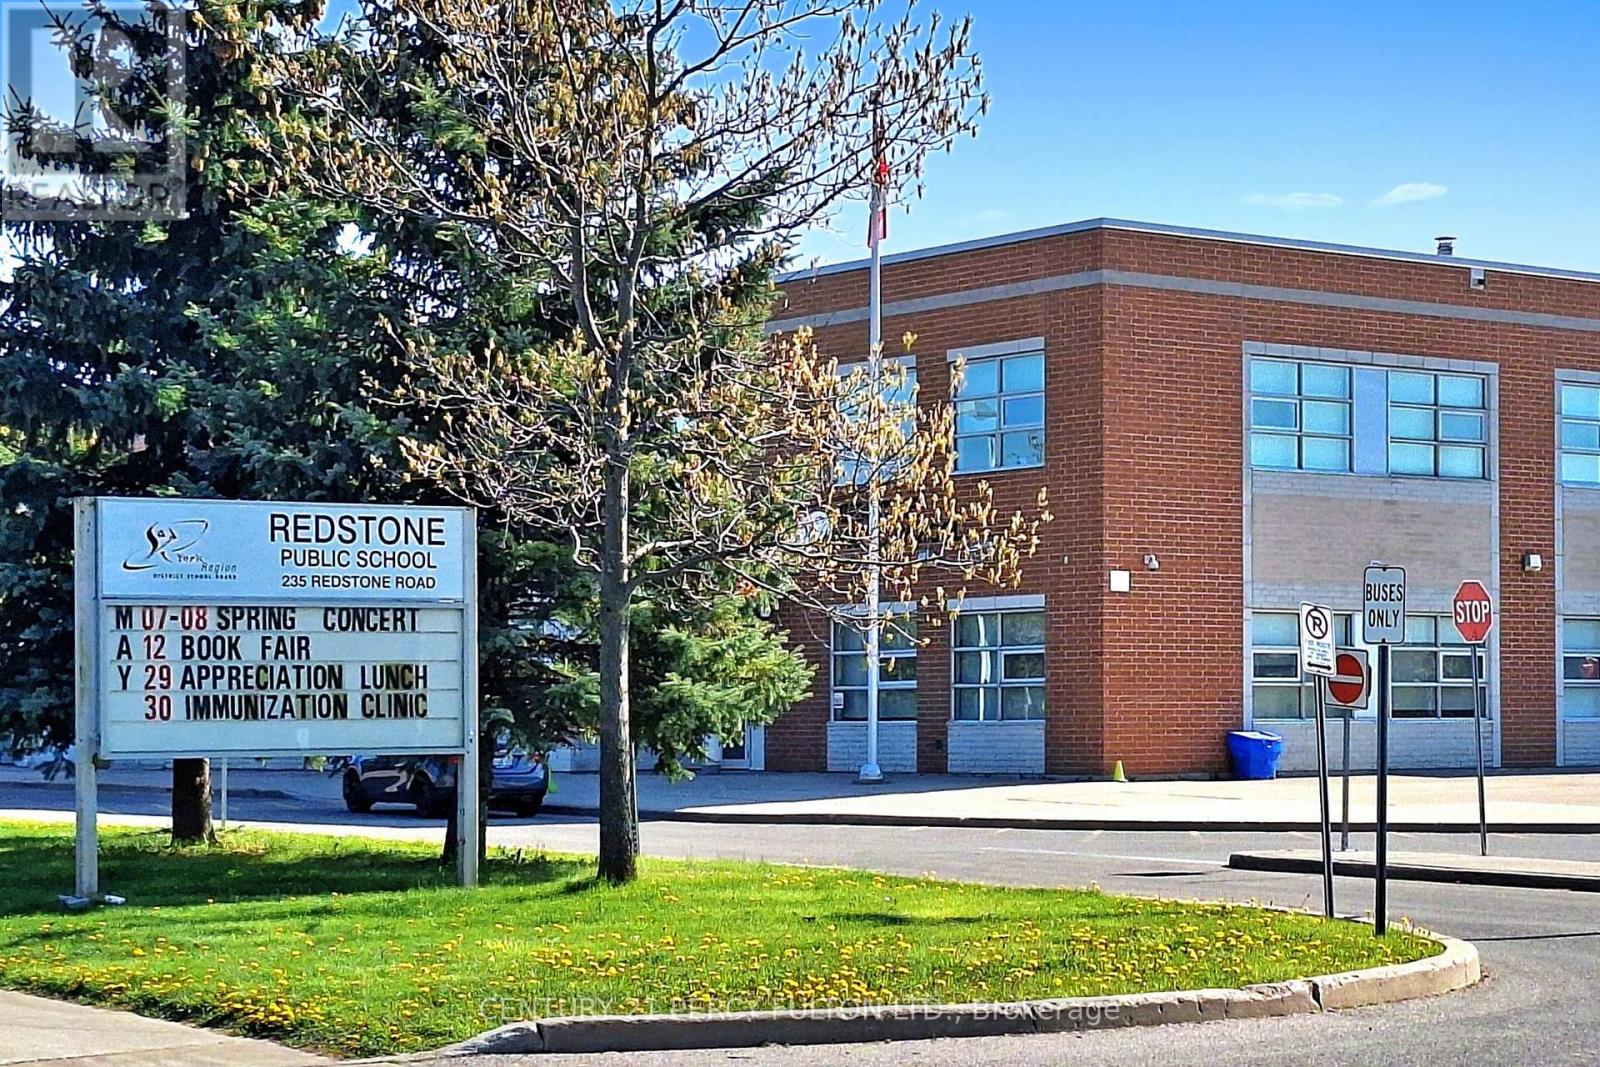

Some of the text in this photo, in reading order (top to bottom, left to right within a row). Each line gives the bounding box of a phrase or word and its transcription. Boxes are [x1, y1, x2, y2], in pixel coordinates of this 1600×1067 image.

[270, 513, 446, 546] REDSTONE
[281, 549, 437, 569] PUBLIC SCHOOL
[282, 575, 436, 589] 235 REDSTONE ROAD
[1366, 583, 1403, 602] BUSES
[142, 606, 420, 632] 07-08 SPRING CONCERT
[1368, 609, 1400, 628] ONLY
[1456, 601, 1490, 624] STOP
[143, 634, 311, 661] 12 BOOK FAIR
[144, 664, 428, 690] 29 APPRECIATION LUNCH
[144, 693, 428, 721] 30 IMMUNIZATION CLINIC
